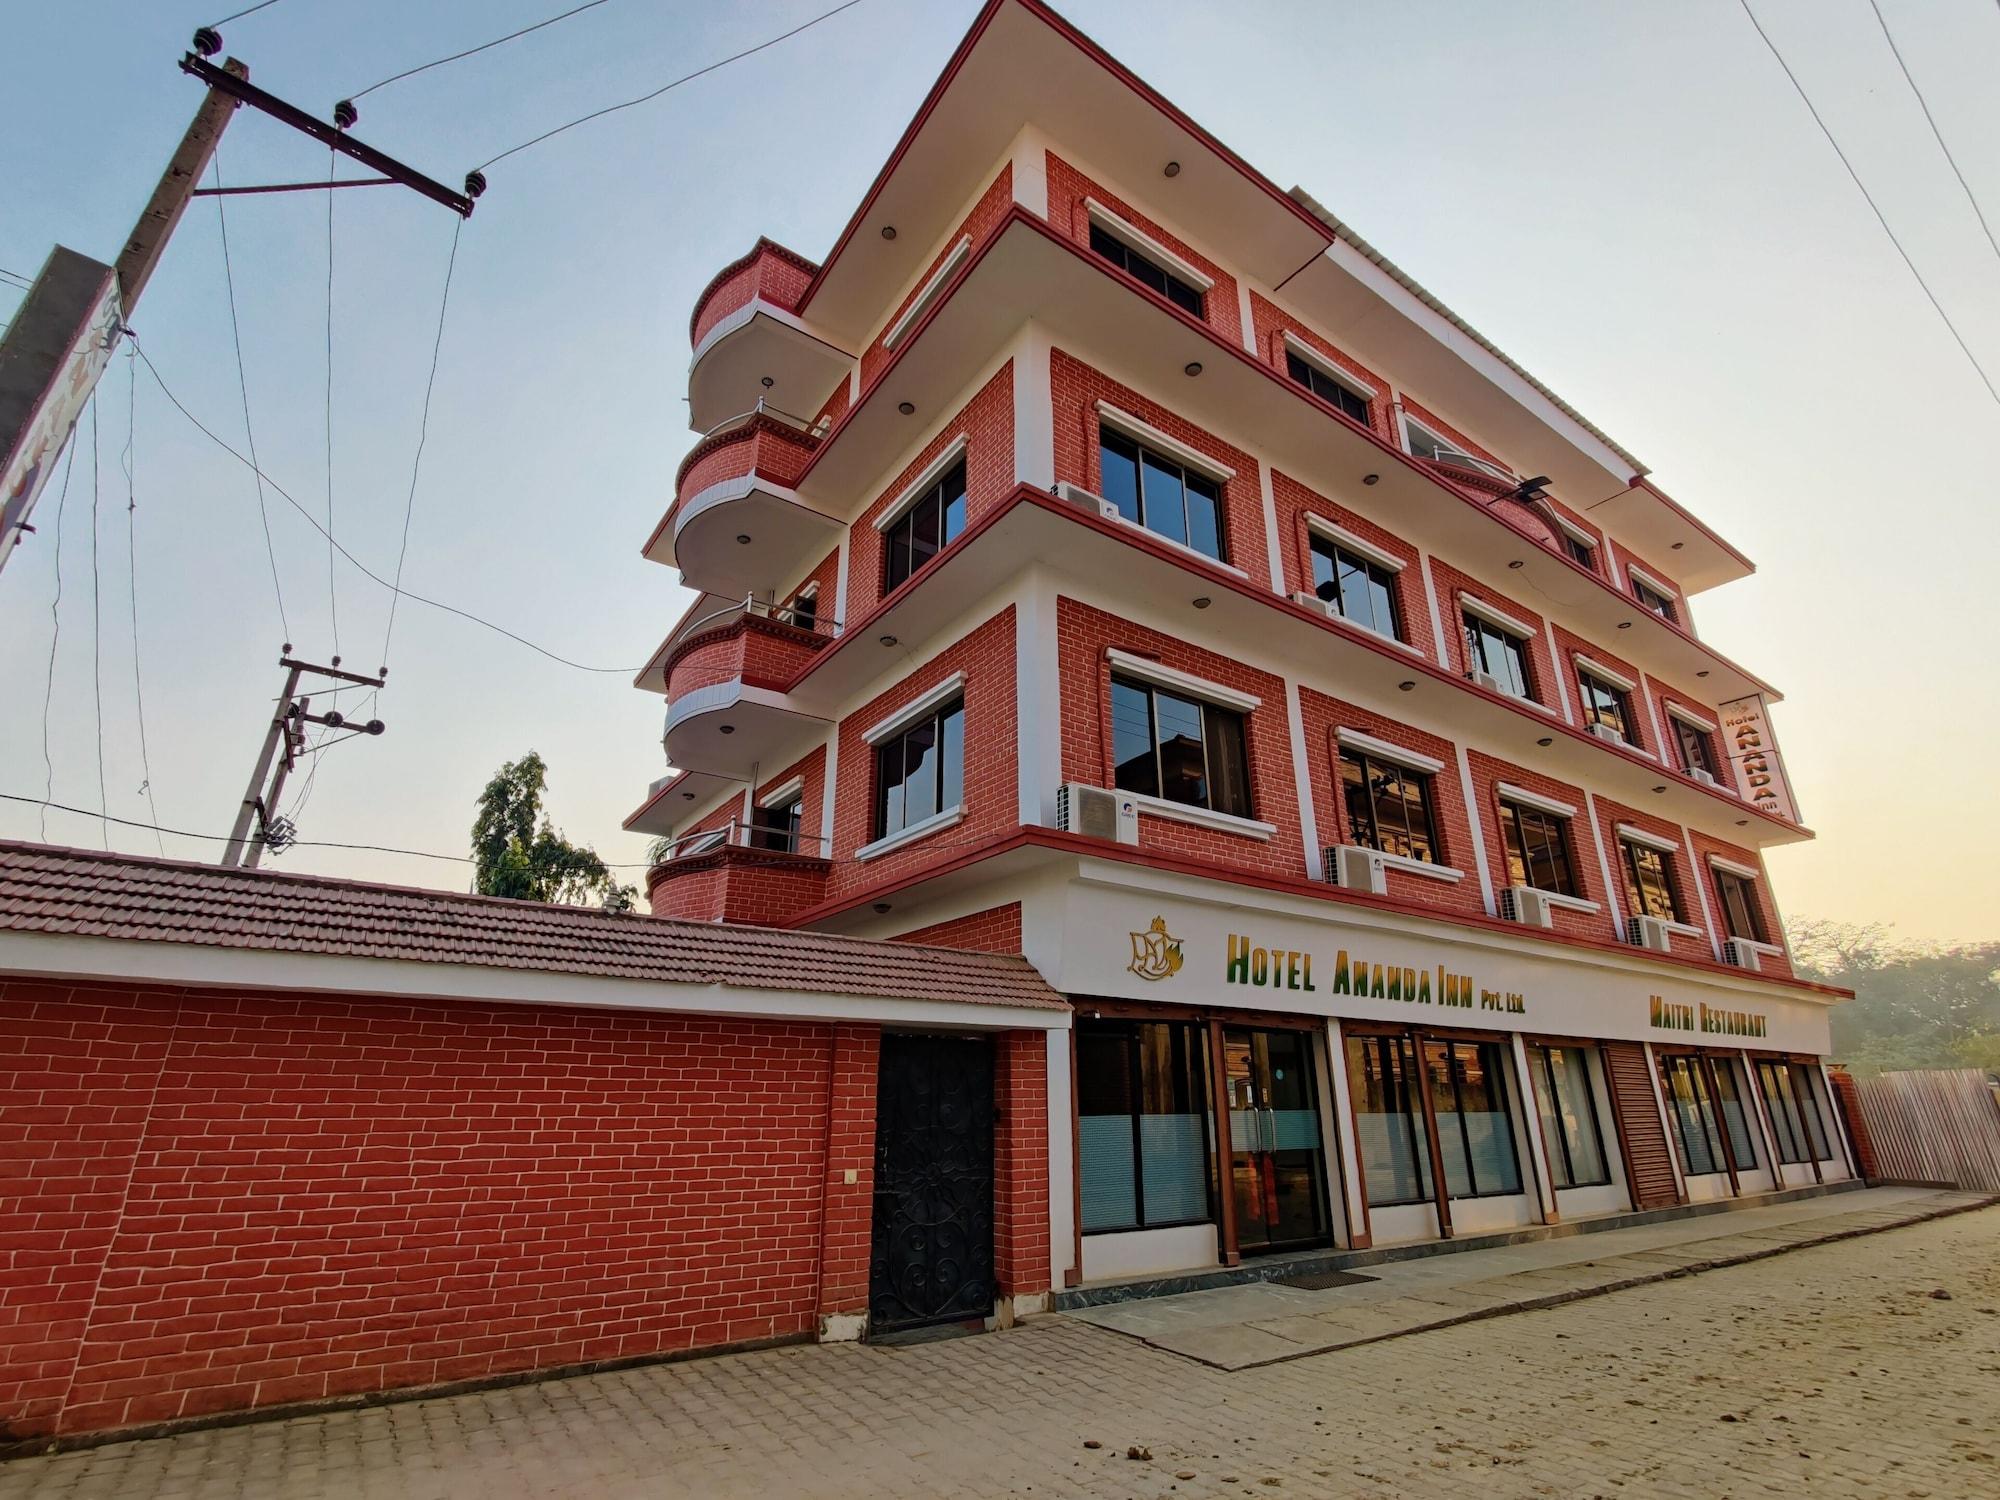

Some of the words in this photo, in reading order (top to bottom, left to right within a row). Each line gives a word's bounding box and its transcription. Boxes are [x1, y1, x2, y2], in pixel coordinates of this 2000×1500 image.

[1726, 713, 1760, 727] Hotel
[1735, 725, 1777, 801] ANANDA
[1226, 934, 1316, 992] HOTEL
[1332, 949, 1431, 1004] ANANDA
[1437, 964, 1473, 1009] INN
[1649, 995, 1694, 1031] MAITRI
[1699, 1002, 1767, 1038] RESTAURANT
